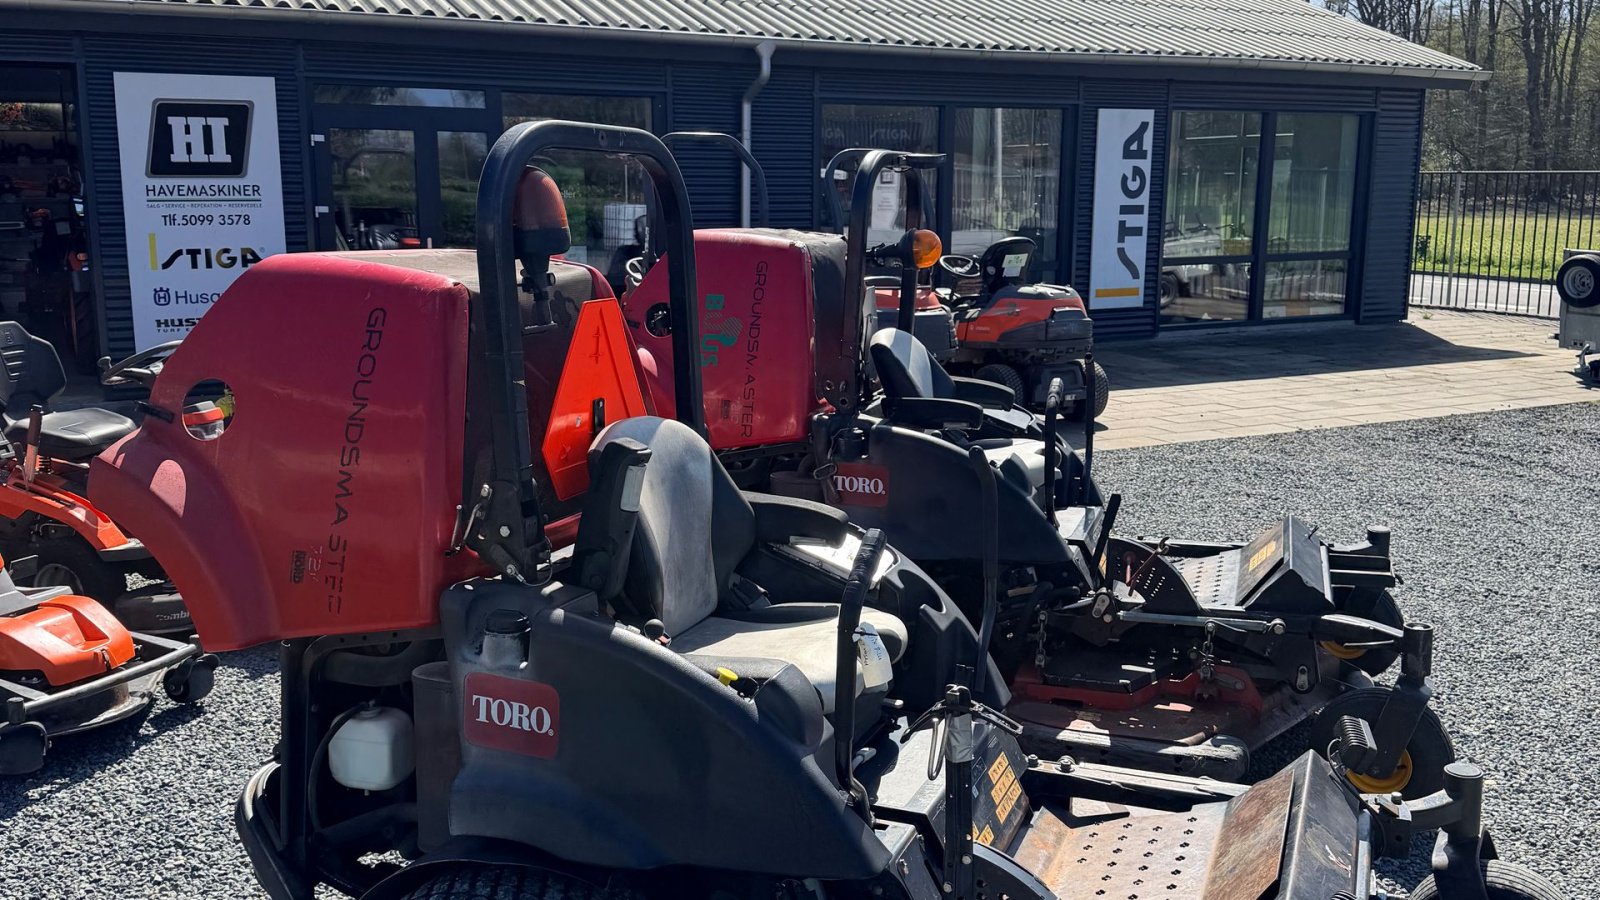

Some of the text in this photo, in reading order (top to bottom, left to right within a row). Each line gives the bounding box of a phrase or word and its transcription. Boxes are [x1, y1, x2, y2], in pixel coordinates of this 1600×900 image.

[167, 116, 232, 163] HI
[145, 184, 262, 197] HAVEMASKINER
[1116, 121, 1150, 280] STIGA
[161, 213, 251, 226] Tlf.5099 3578
[161, 247, 264, 270] STIGA
[174, 290, 222, 305] Husq
[741, 260, 769, 438] GROUNDSMASTER
[833, 475, 884, 494] TORO
[472, 694, 551, 734] TORO
